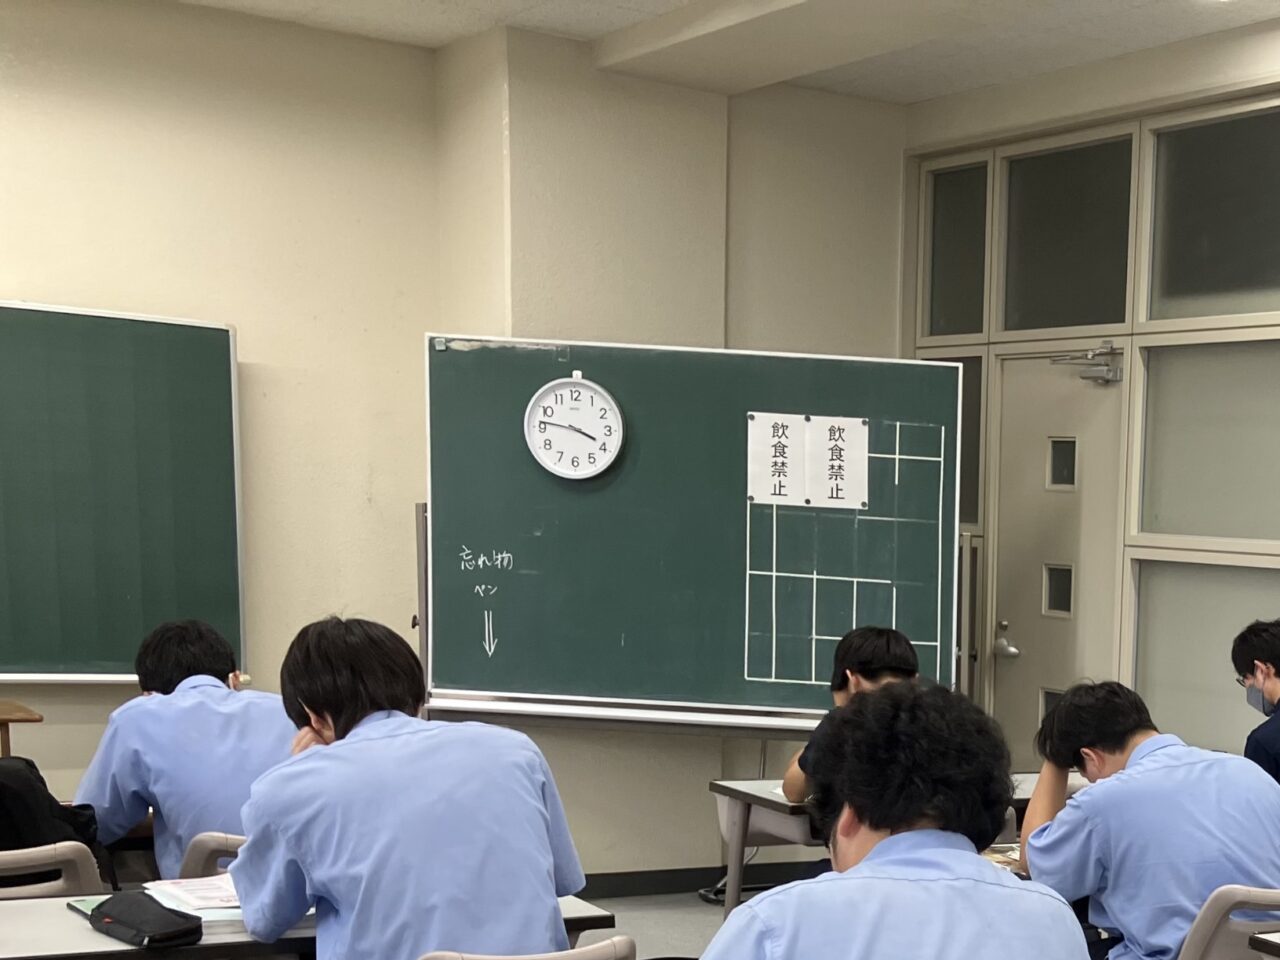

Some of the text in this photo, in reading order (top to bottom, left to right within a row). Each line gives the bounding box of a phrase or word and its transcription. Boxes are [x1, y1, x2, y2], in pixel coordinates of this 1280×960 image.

[554, 393, 564, 405] 11
[569, 389, 582, 402] 12
[589, 395, 594, 407] 1
[542, 405, 554, 418] 10
[599, 407, 608, 420] 2
[538, 421, 547, 433] 9
[603, 425, 612, 437] 3
[543, 438, 552, 450] 8
[598, 442, 607, 453] 4
[556, 451, 564, 463] 7
[571, 456, 580, 468] 6
[588, 452, 596, 465] 5
[770, 421, 789, 497] 飲食禁止
[827, 424, 846, 500] 飲食禁止
[459, 544, 514, 570] 忘れ物
[474, 584, 498, 597] ペン
